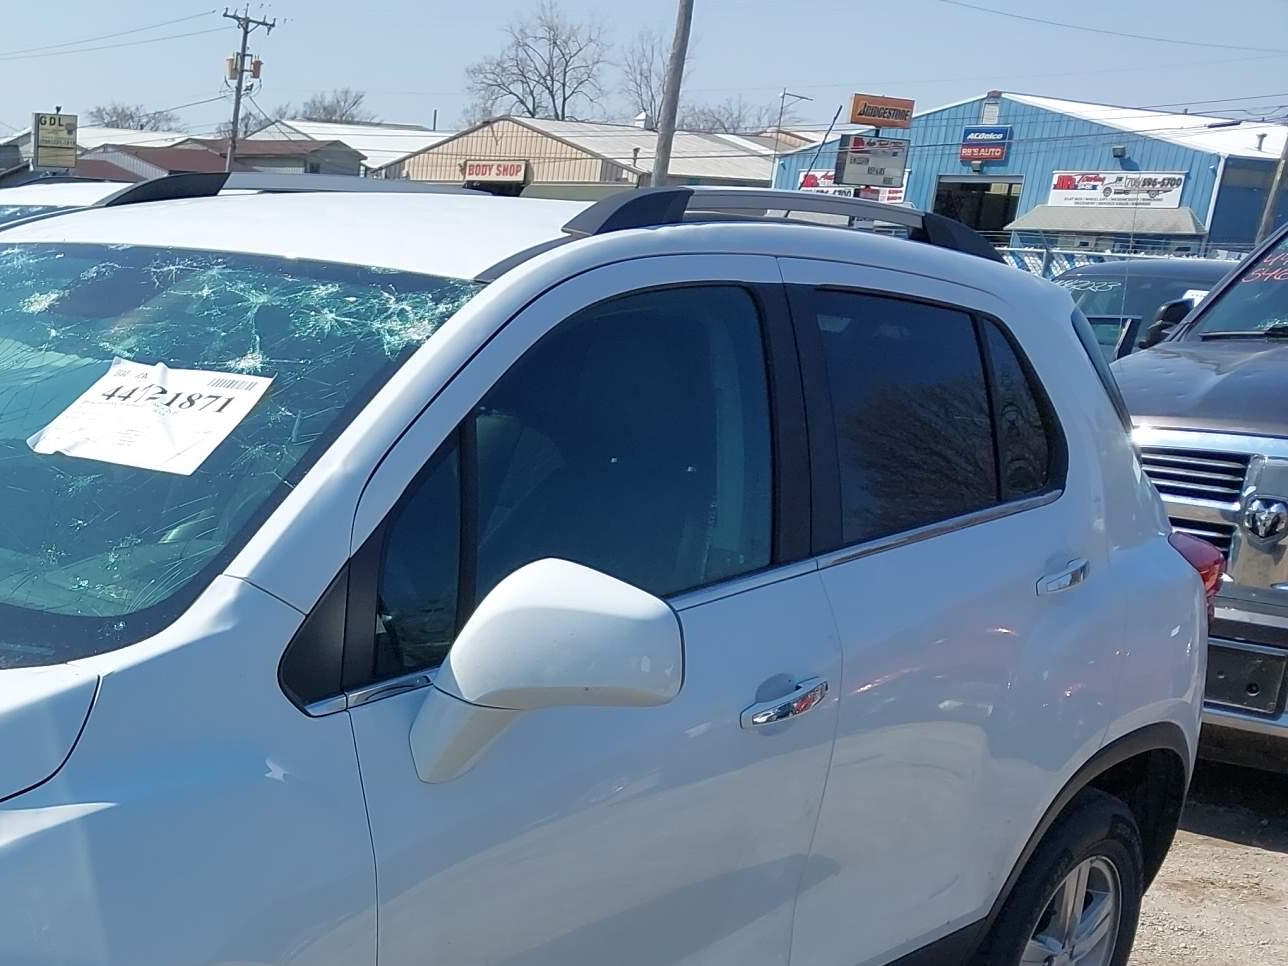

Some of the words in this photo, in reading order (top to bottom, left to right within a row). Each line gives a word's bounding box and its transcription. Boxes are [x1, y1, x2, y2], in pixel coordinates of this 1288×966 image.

[857, 102, 912, 121] BRIDGESTONE
[39, 115, 65, 127] GDL
[966, 132, 1004, 141] ACDelco
[979, 148, 1002, 156] AUTO
[468, 163, 494, 177] BODY
[496, 163, 523, 177] SHOP
